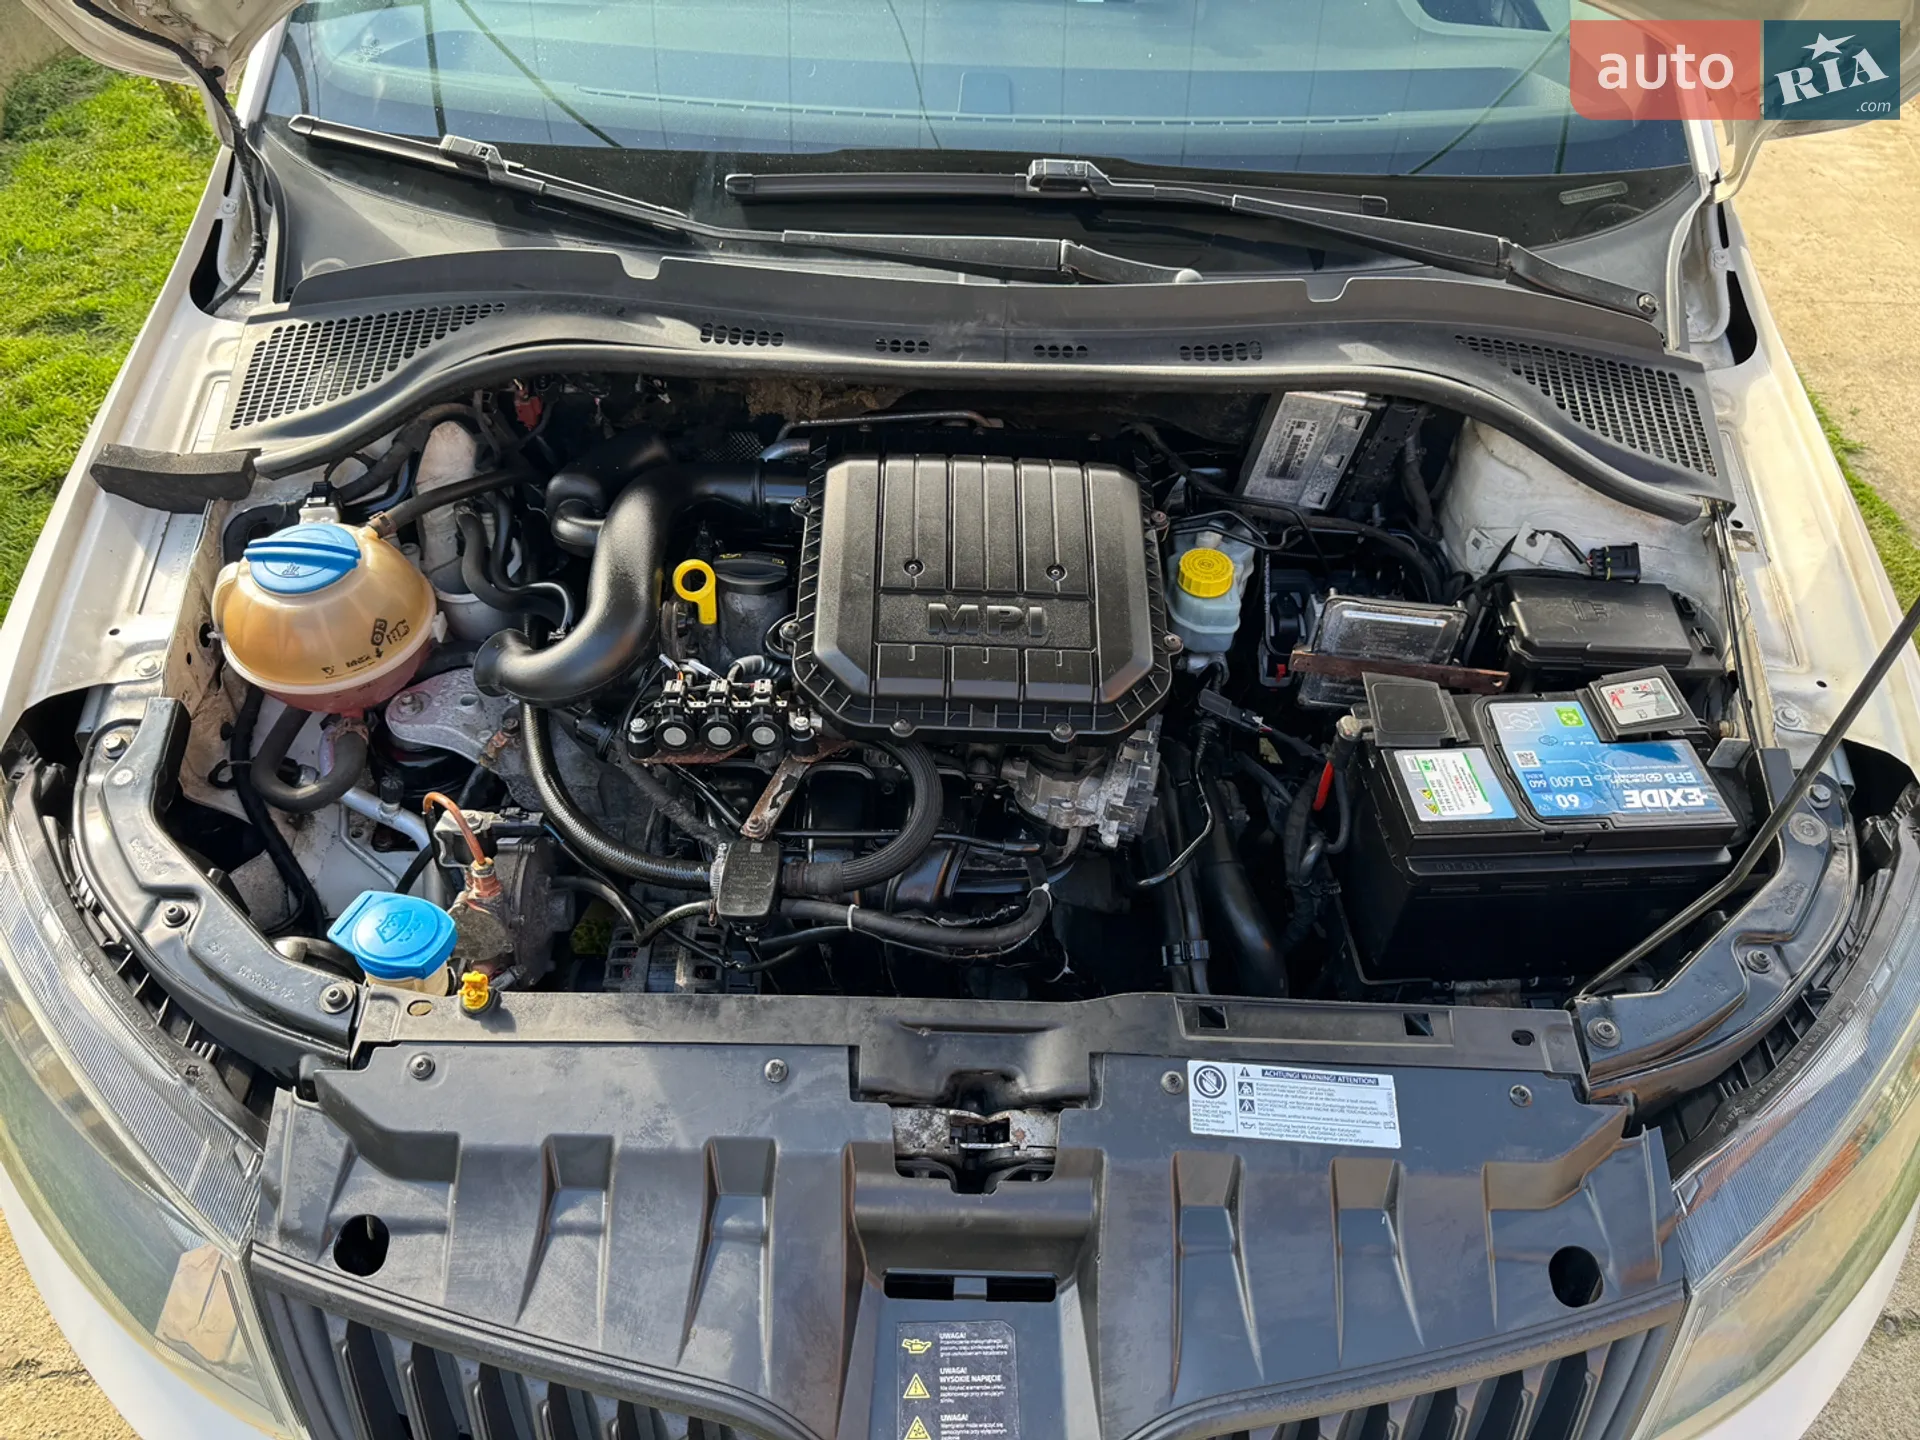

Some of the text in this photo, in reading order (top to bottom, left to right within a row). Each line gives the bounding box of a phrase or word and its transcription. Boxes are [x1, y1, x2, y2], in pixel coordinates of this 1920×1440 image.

[927, 603, 1043, 637] MPI
[1549, 775, 1593, 788] EL600
[1664, 771, 1697, 784] EFB
[1555, 793, 1580, 809] 60
[1622, 787, 1707, 809] EXIDE
[1264, 1070, 1377, 1085] ACHTUNG! WARNING! ATTENTION!
